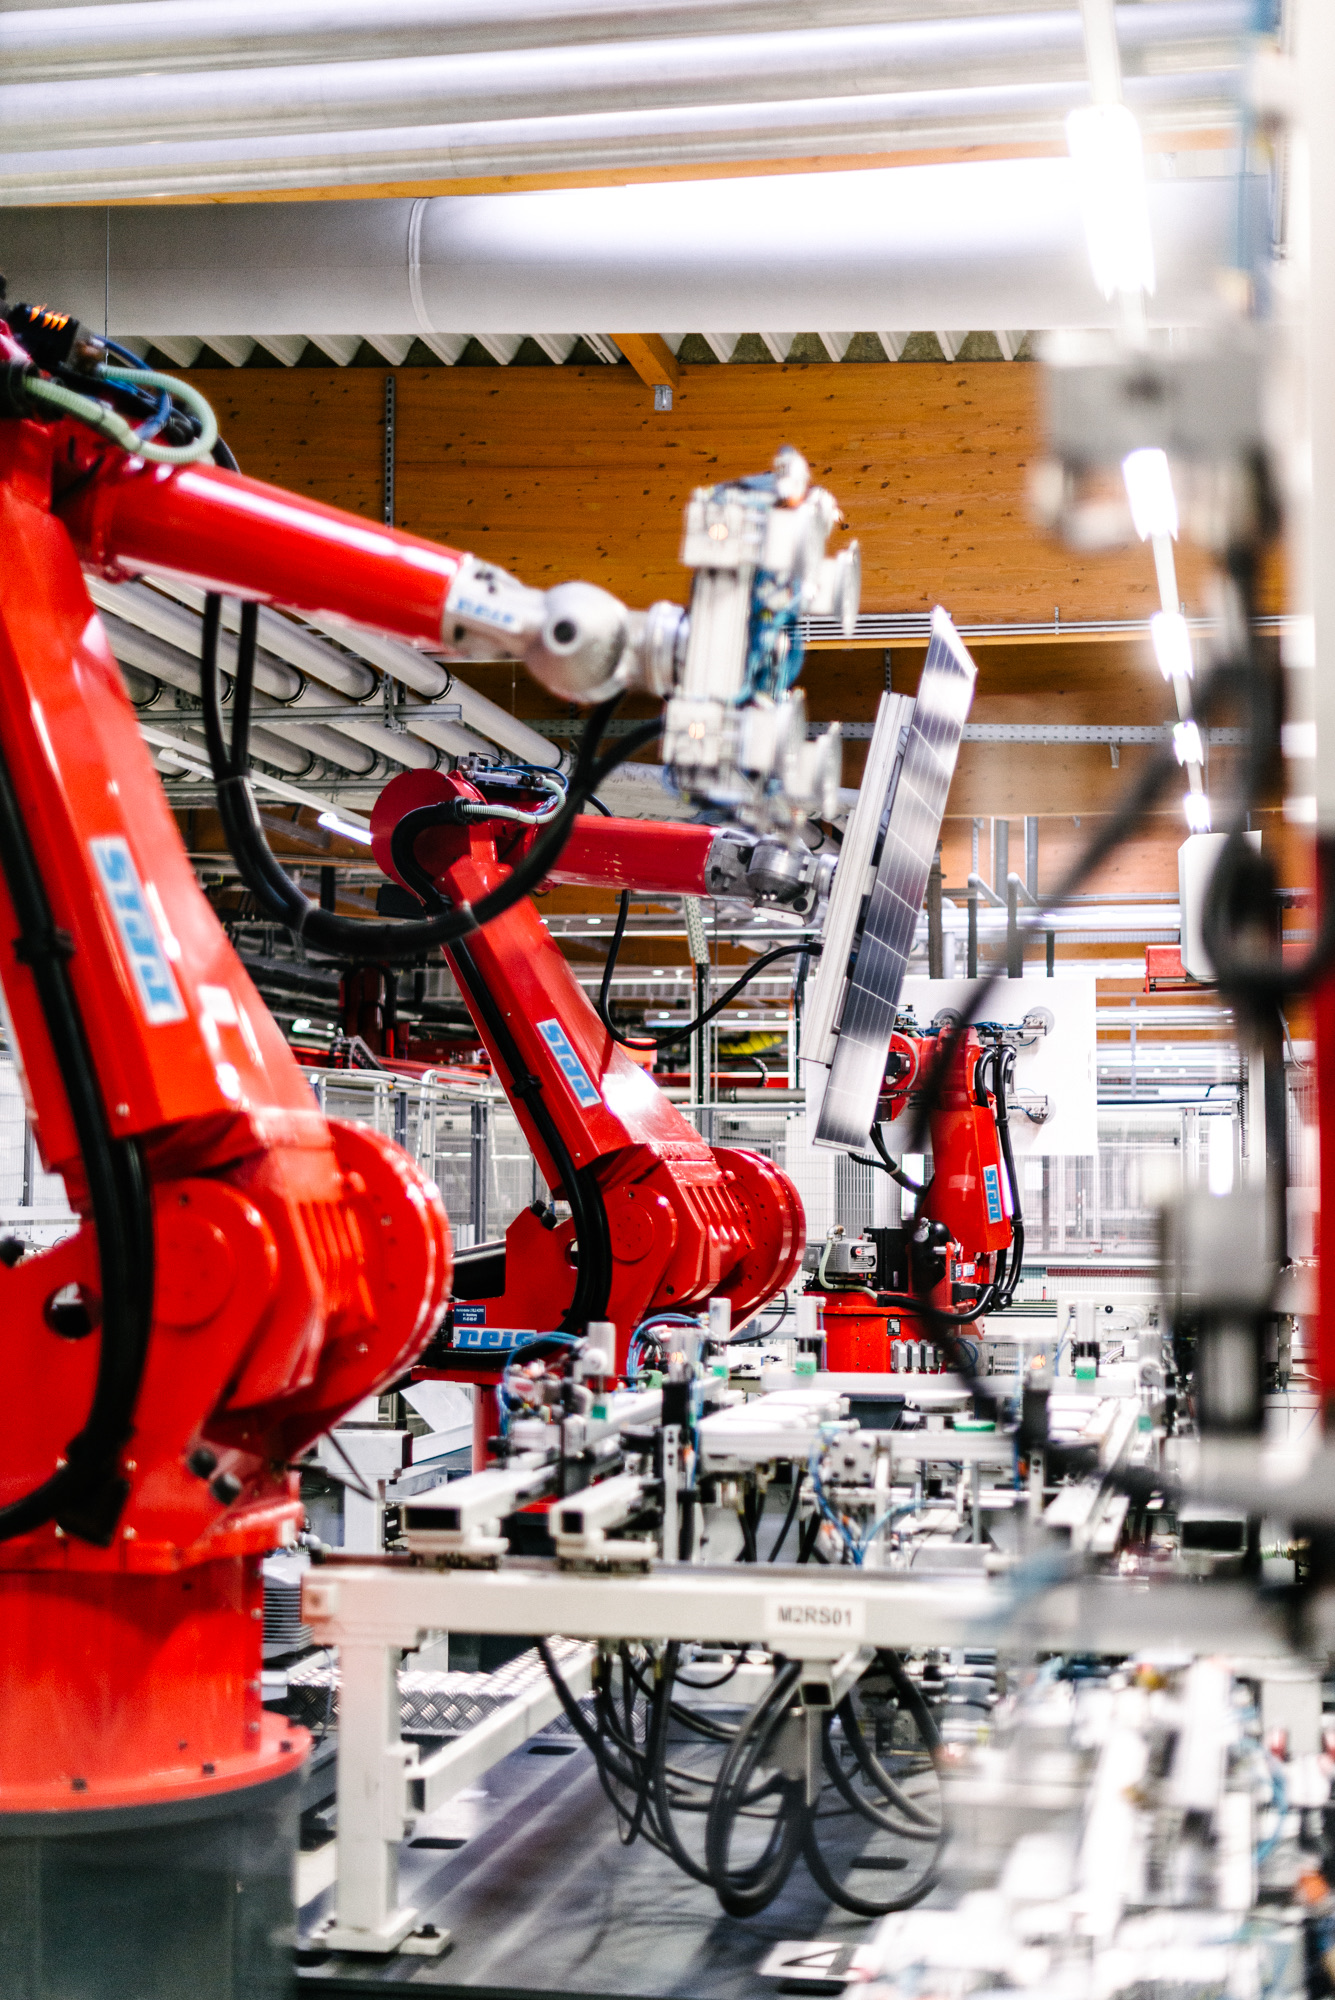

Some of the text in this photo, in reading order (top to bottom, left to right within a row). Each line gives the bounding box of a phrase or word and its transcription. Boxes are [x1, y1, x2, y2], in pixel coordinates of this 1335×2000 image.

[541, 1024, 599, 1101] reis
[985, 1169, 1001, 1220] reis
[778, 1606, 851, 1625] M2RS01
